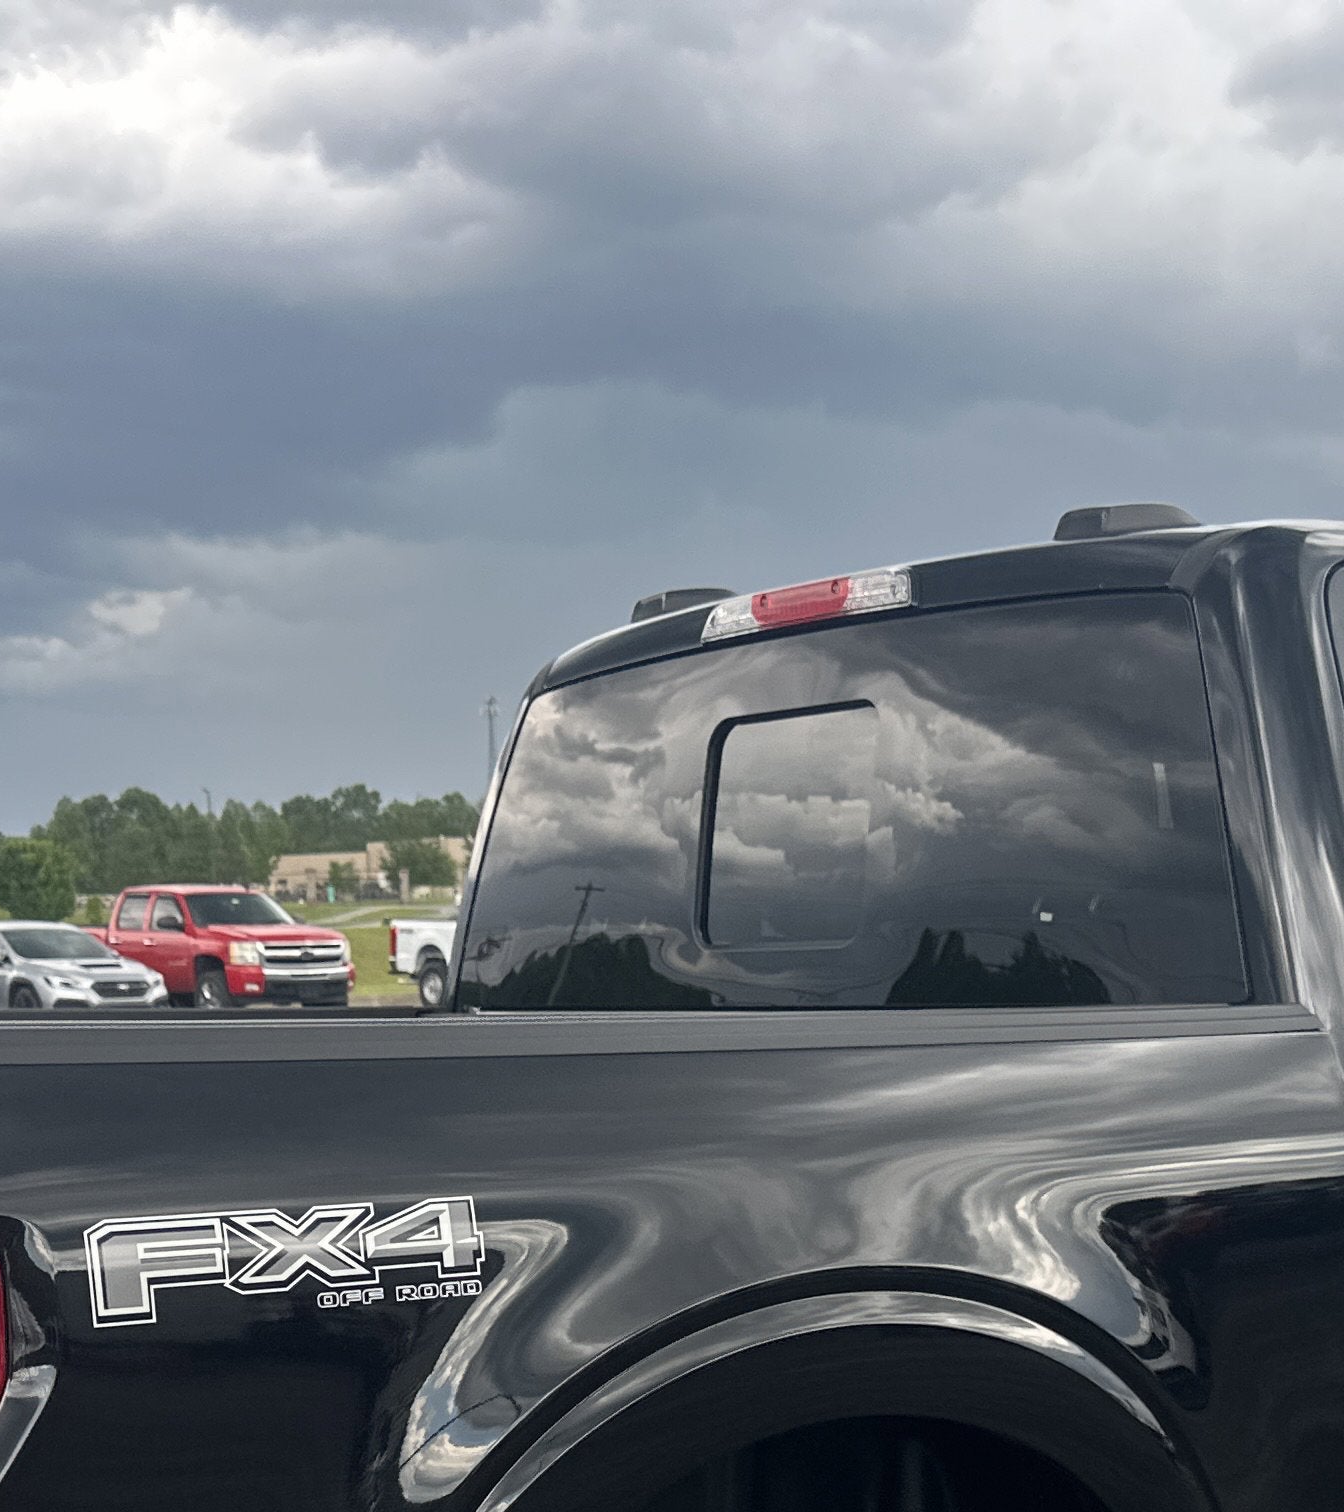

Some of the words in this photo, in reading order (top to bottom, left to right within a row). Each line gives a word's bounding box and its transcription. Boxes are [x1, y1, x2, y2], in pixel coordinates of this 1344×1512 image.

[83, 1196, 485, 1328] FX4
[316, 1288, 385, 1309] OFF
[395, 1279, 483, 1302] ROAD
